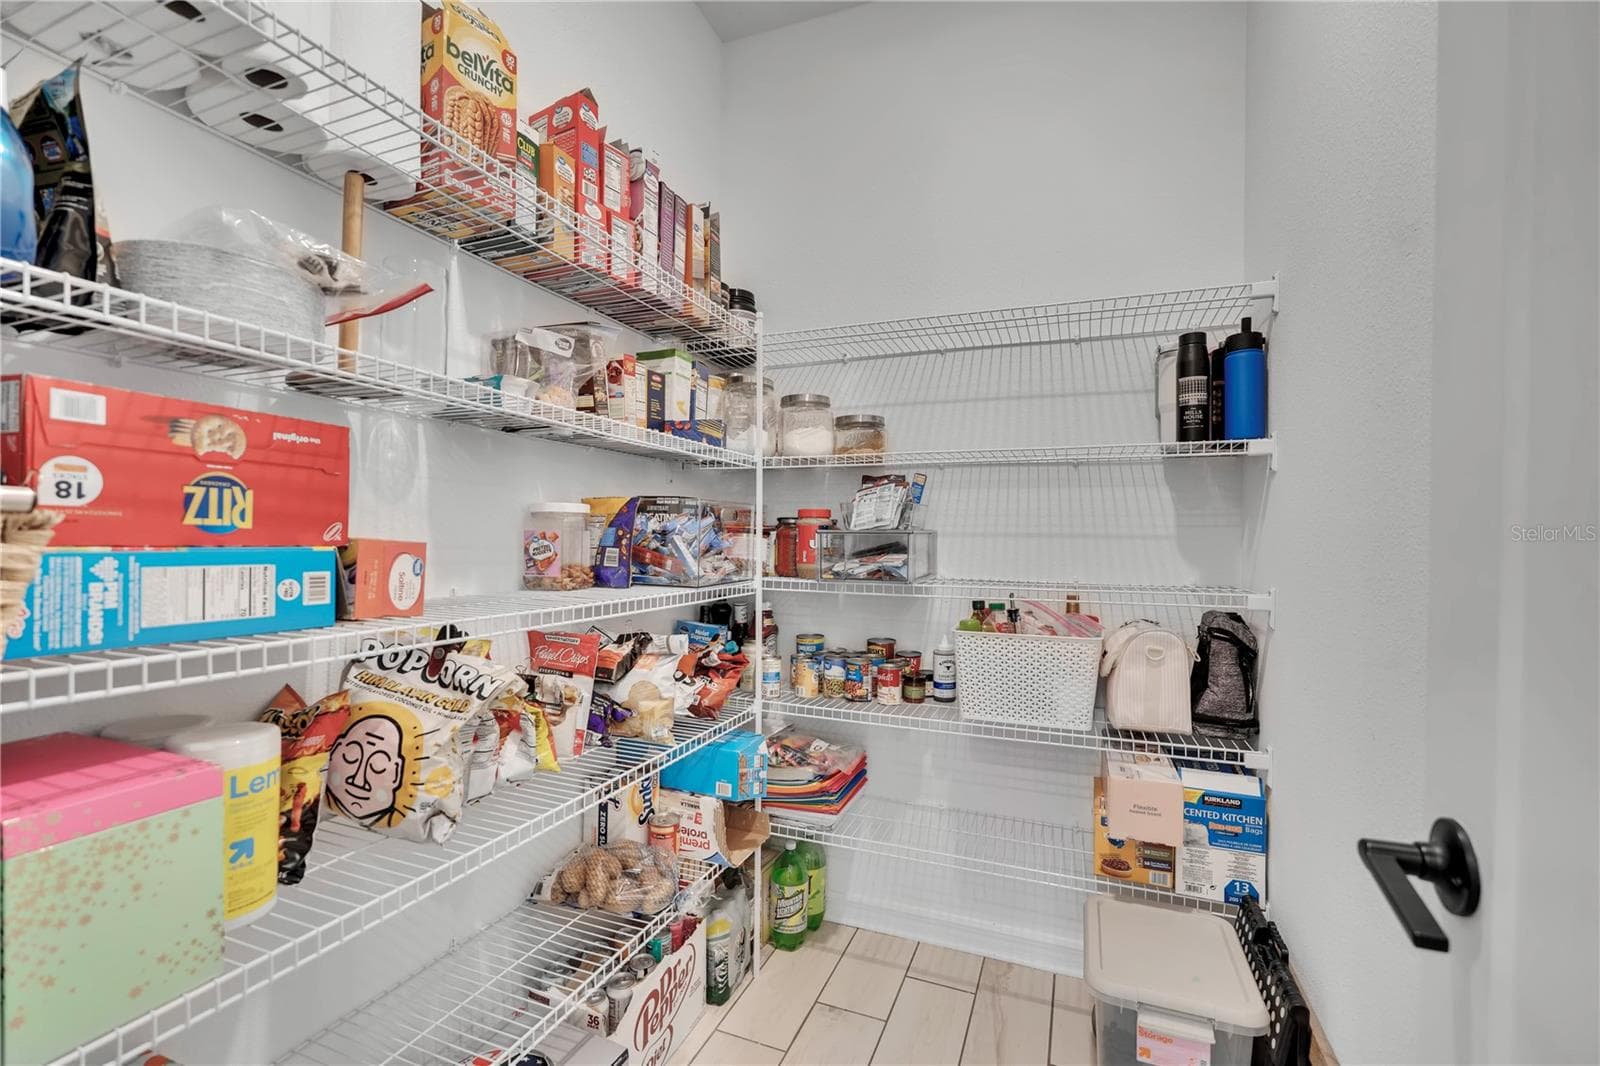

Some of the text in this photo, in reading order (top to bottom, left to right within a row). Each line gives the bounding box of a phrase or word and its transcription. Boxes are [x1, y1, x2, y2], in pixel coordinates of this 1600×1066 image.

[446, 35, 514, 95] belVita
[457, 63, 503, 97] CRUNCHY
[272, 432, 309, 446] original
[54, 481, 87, 501] 18
[182, 485, 255, 530] RITZ
[88, 581, 104, 646] BRANDS
[354, 670, 471, 715] HIMALAYAN GOLD
[1204, 795, 1241, 807] KIRKLAND
[599, 810, 607, 834] ZERO
[1221, 811, 1264, 826] KITCHEN
[680, 823, 708, 839] prote
[1244, 825, 1264, 837] Bags
[1233, 881, 1250, 894] 13
[660, 958, 683, 993] Dr
[634, 955, 693, 1051] Pepper
[587, 1014, 600, 1026] 36
